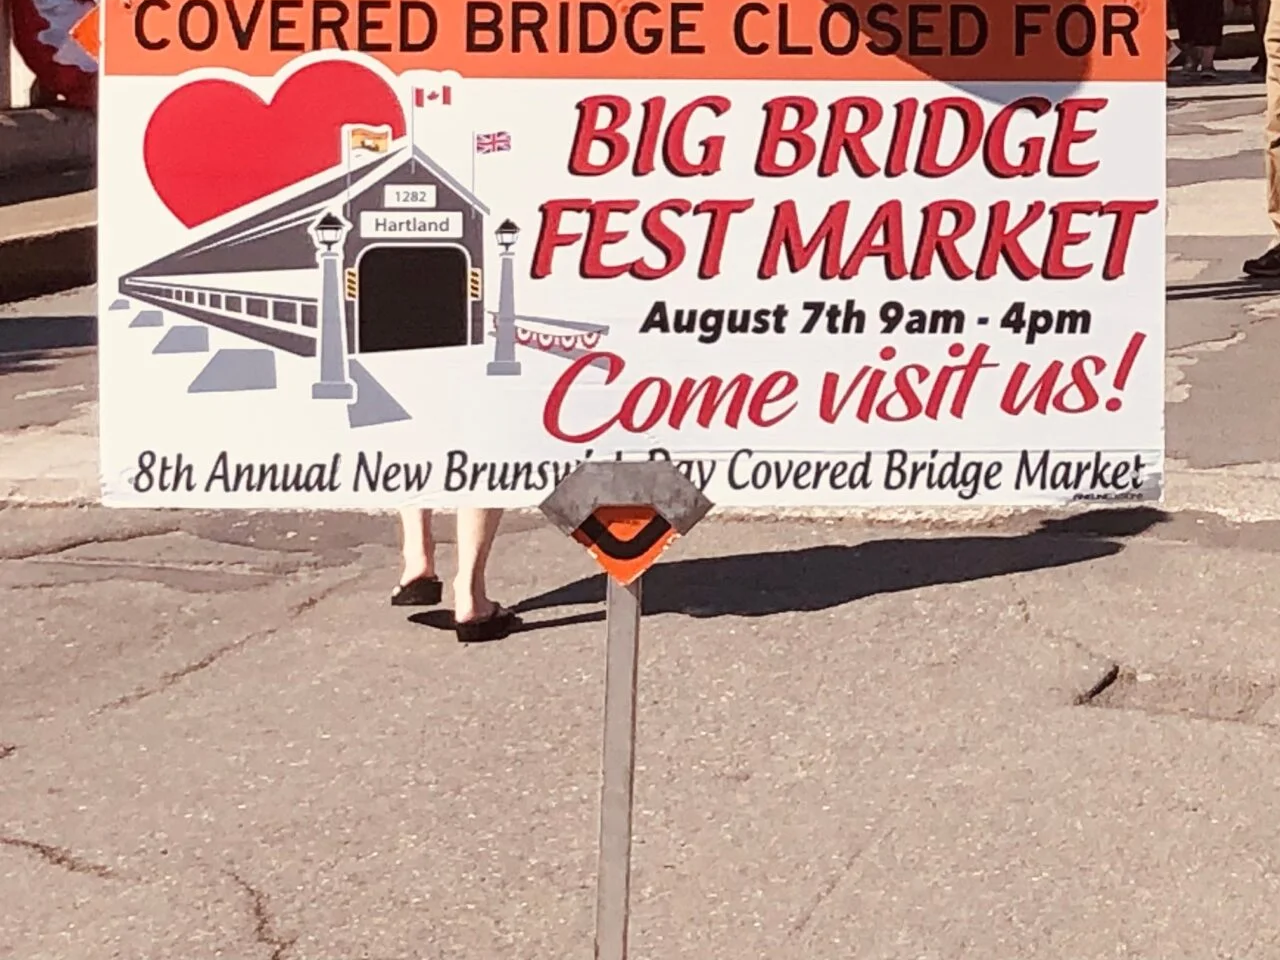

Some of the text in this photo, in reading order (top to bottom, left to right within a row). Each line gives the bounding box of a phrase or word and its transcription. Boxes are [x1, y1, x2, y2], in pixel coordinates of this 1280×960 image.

[465, 0, 706, 55] BRIDGE
[733, 1, 988, 57] CLOSED
[1014, 3, 1141, 57] FOR
[566, 94, 1109, 179] BIG BRIDGE
[394, 190, 427, 204] 1282
[373, 216, 450, 234] Hartland
[529, 197, 1160, 281] FEST MARKET
[639, 300, 1092, 344] August 7th 9am - 4pm
[541, 330, 1147, 444] Come visit us!
[132, 450, 197, 494] 8th
[204, 450, 342, 494] Annual
[353, 451, 432, 494] New
[443, 448, 623, 493] Brunsw
[726, 449, 872, 493] Covered
[883, 448, 1003, 500] Bridge
[1011, 448, 1146, 493] Market
